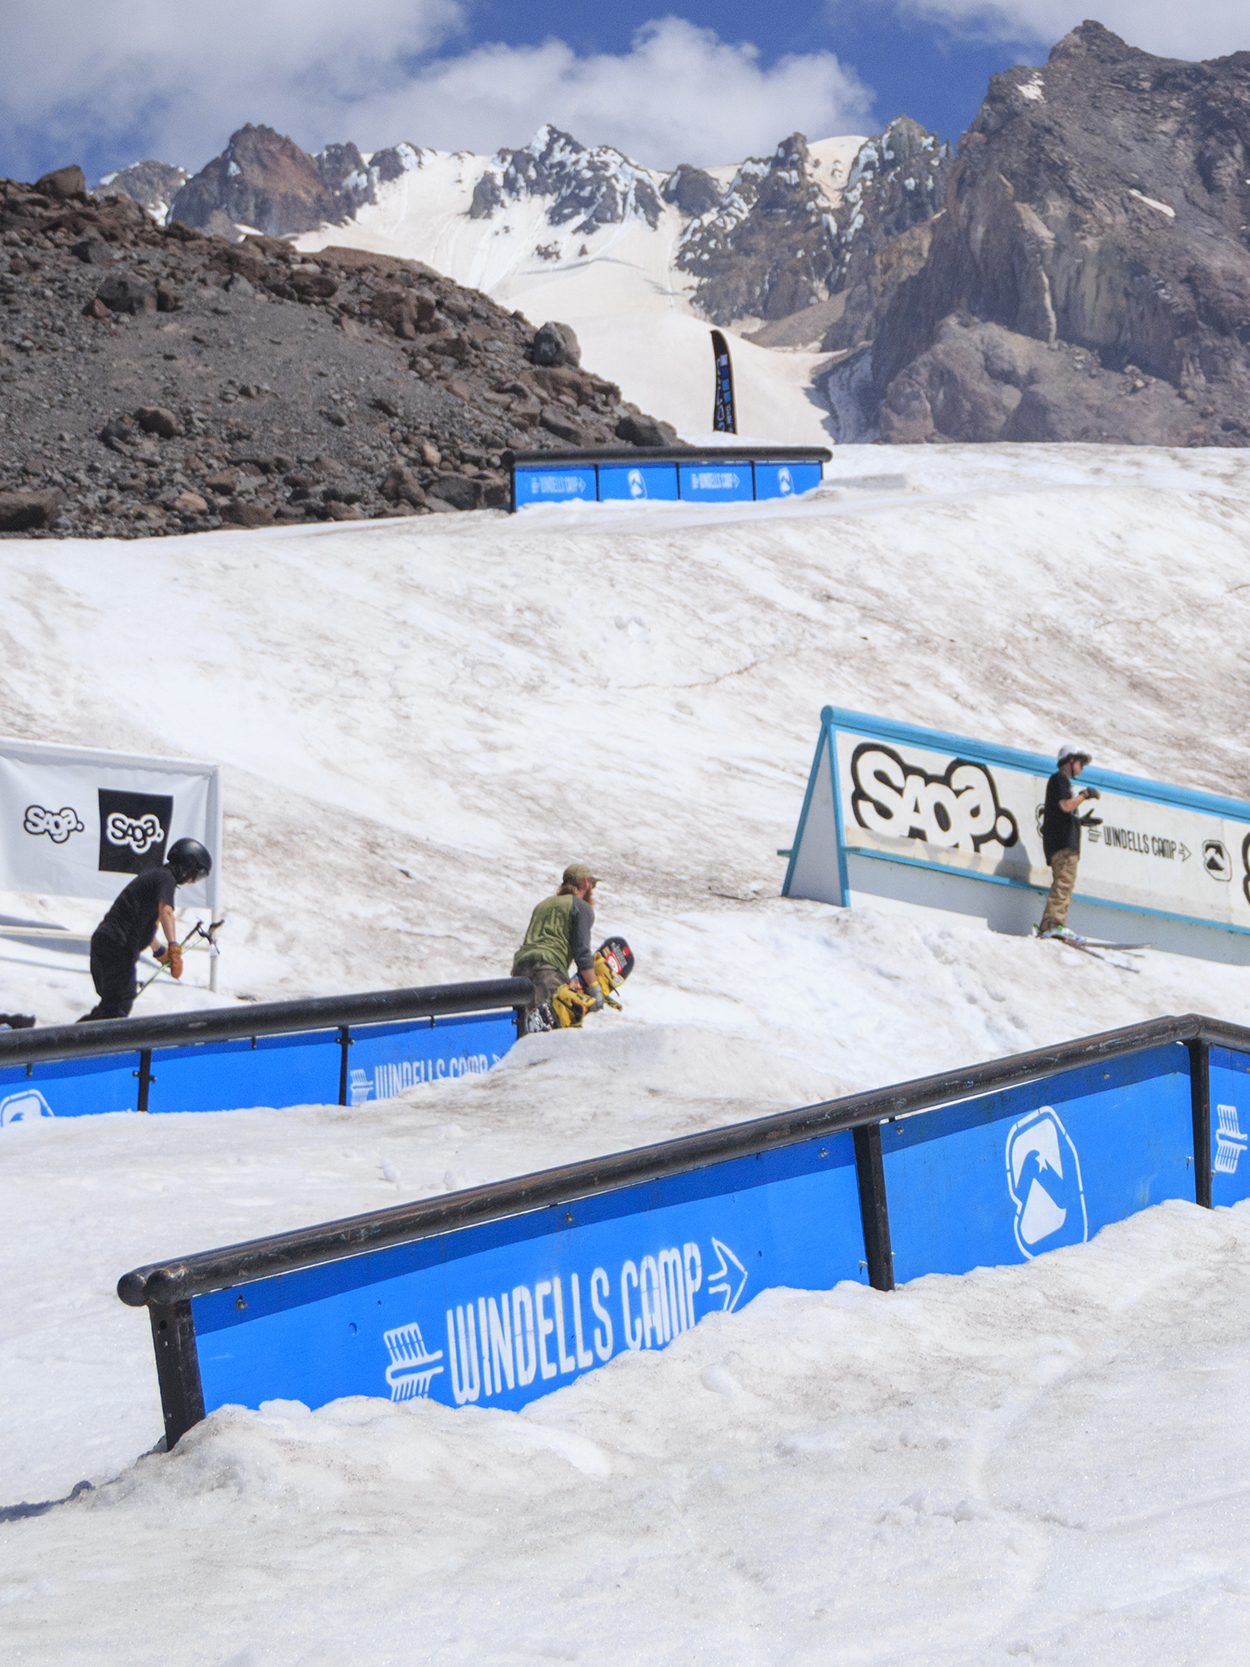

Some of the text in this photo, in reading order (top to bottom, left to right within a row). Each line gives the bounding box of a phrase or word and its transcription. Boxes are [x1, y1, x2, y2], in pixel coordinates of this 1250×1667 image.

[1103, 825, 1177, 860] WINDELLS CAMP
[446, 1241, 703, 1405] WINDELLS CAMP
